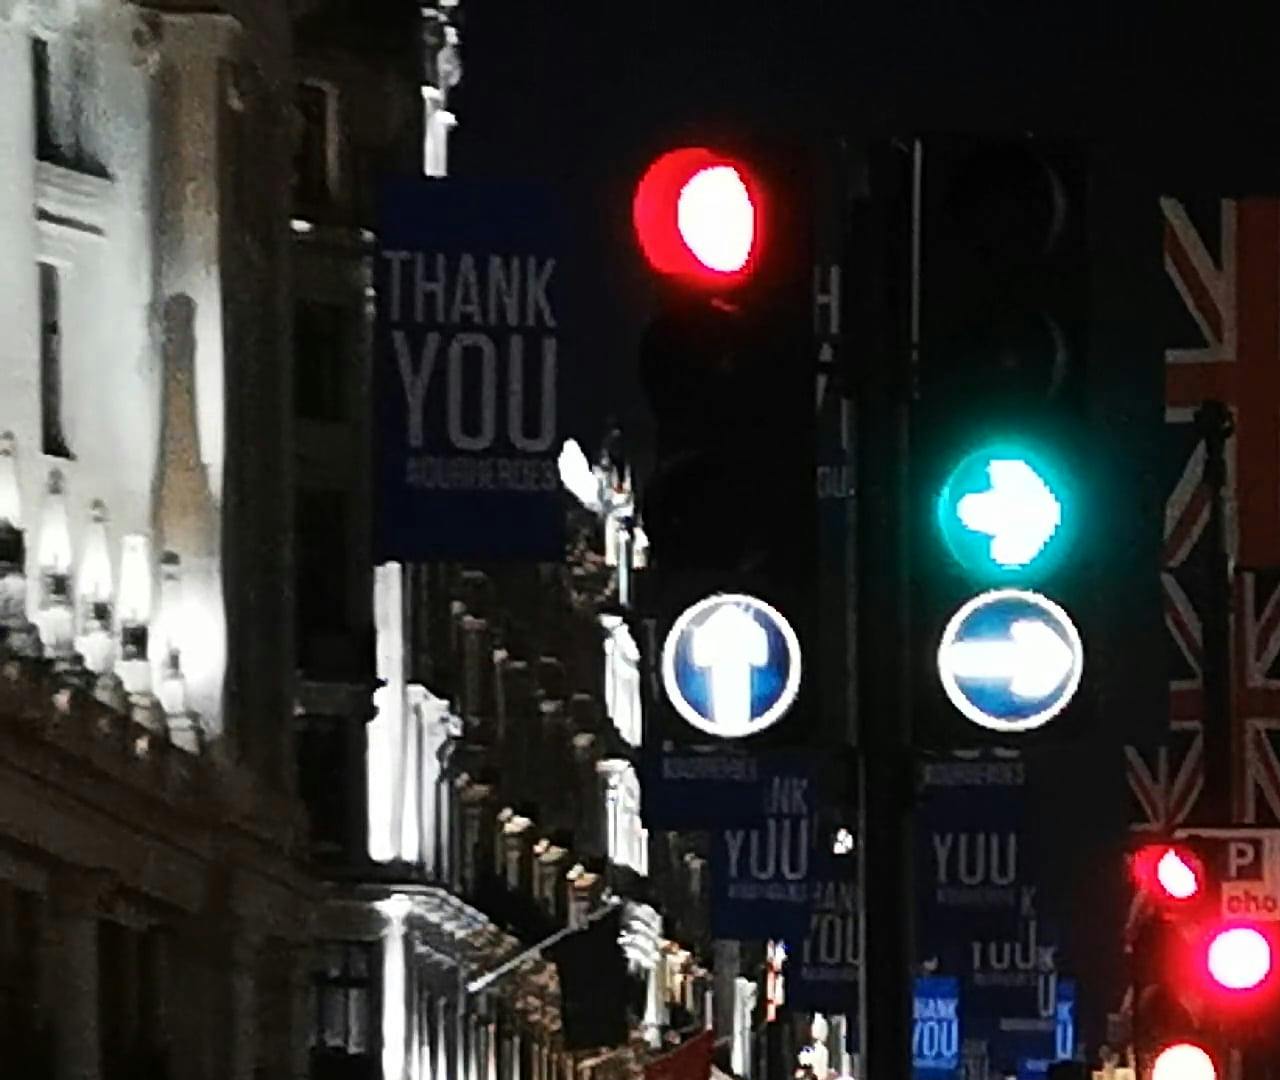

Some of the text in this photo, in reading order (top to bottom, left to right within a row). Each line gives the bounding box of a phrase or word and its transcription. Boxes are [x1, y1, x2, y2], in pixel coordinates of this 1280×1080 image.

[381, 250, 557, 328] THANK
[391, 329, 558, 453] YOU
[1229, 842, 1255, 878] P
